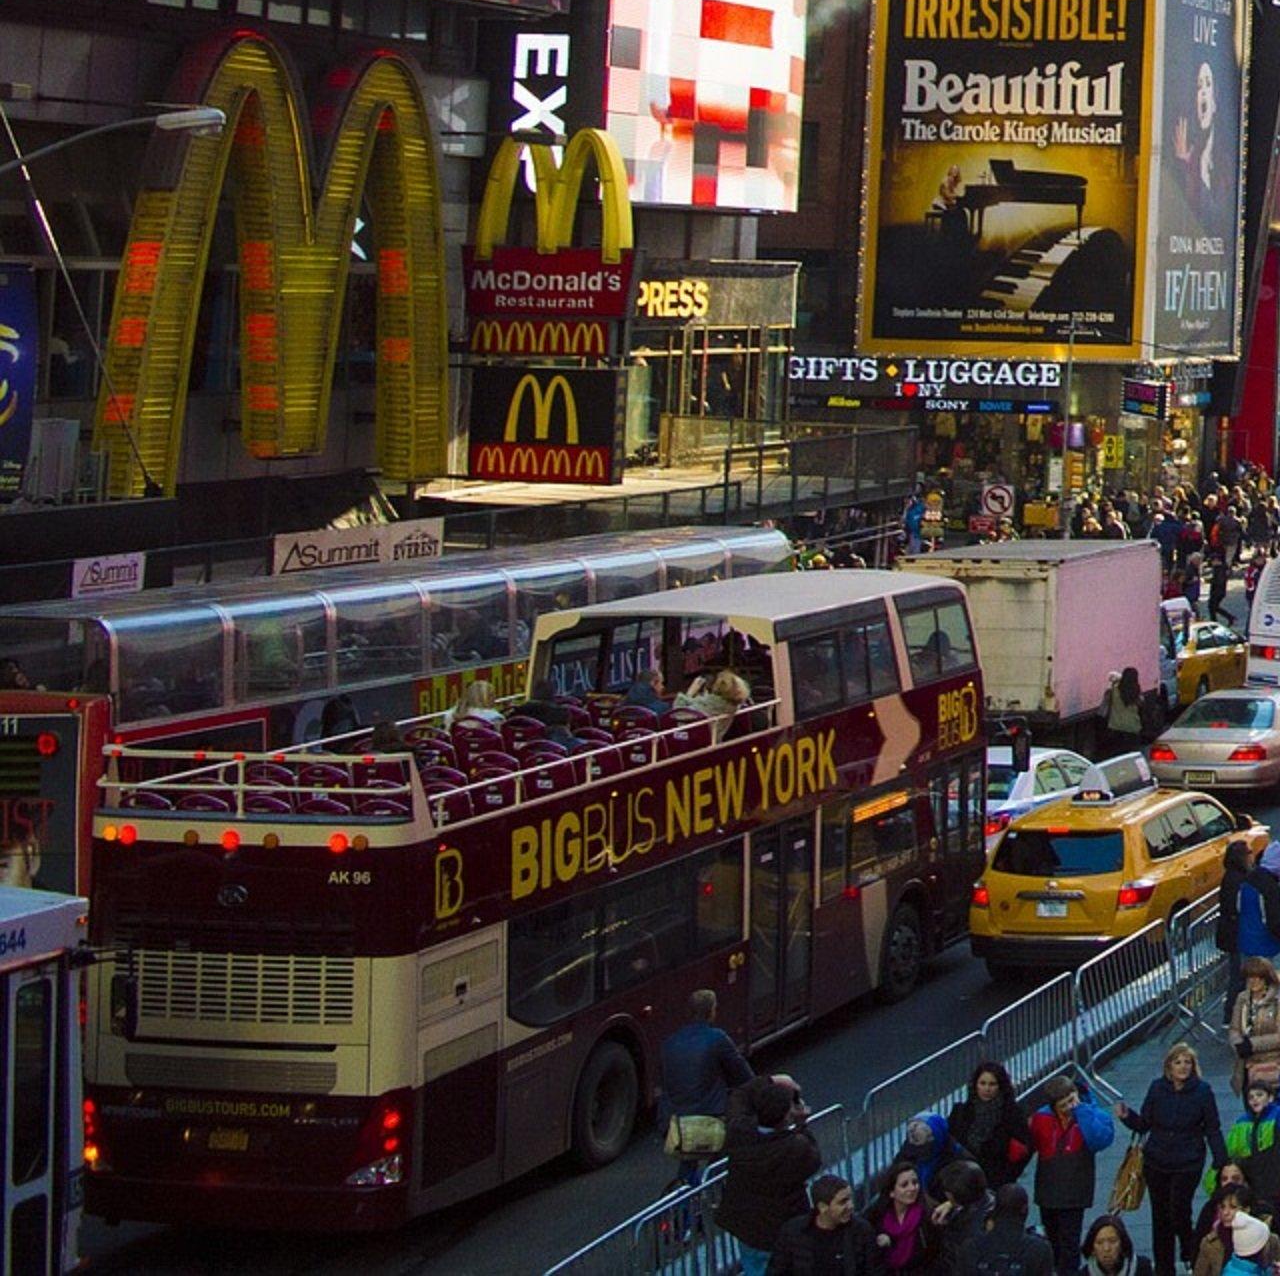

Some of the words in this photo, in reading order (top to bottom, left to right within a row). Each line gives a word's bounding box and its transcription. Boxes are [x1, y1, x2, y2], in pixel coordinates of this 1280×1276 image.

[1193, 15, 1219, 47] LIVE
[902, 59, 1125, 117] Beautiful
[902, 117, 938, 142] The
[940, 119, 1001, 143] Carole
[1003, 120, 1049, 148] King
[1051, 122, 1123, 145] Musical
[471, 268, 622, 292] McDonald's
[1164, 263, 1228, 319] IF/THEN
[495, 294, 595, 310] Restaurant
[788, 357, 878, 382] GIFTS
[904, 360, 1061, 387] LUGGAGE
[918, 383, 946, 398] NY
[925, 399, 970, 412] SONY
[301, 538, 381, 567] Summit
[392, 541, 440, 563] EVEREST
[90, 560, 140, 585] Summit
[937, 690, 960, 723] BIG
[665, 756, 747, 845] NEW
[755, 727, 839, 812] YORK
[328, 871, 349, 885] AK
[352, 871, 372, 885] 96
[164, 1097, 292, 1119] BIGBUSTOURS.COM
